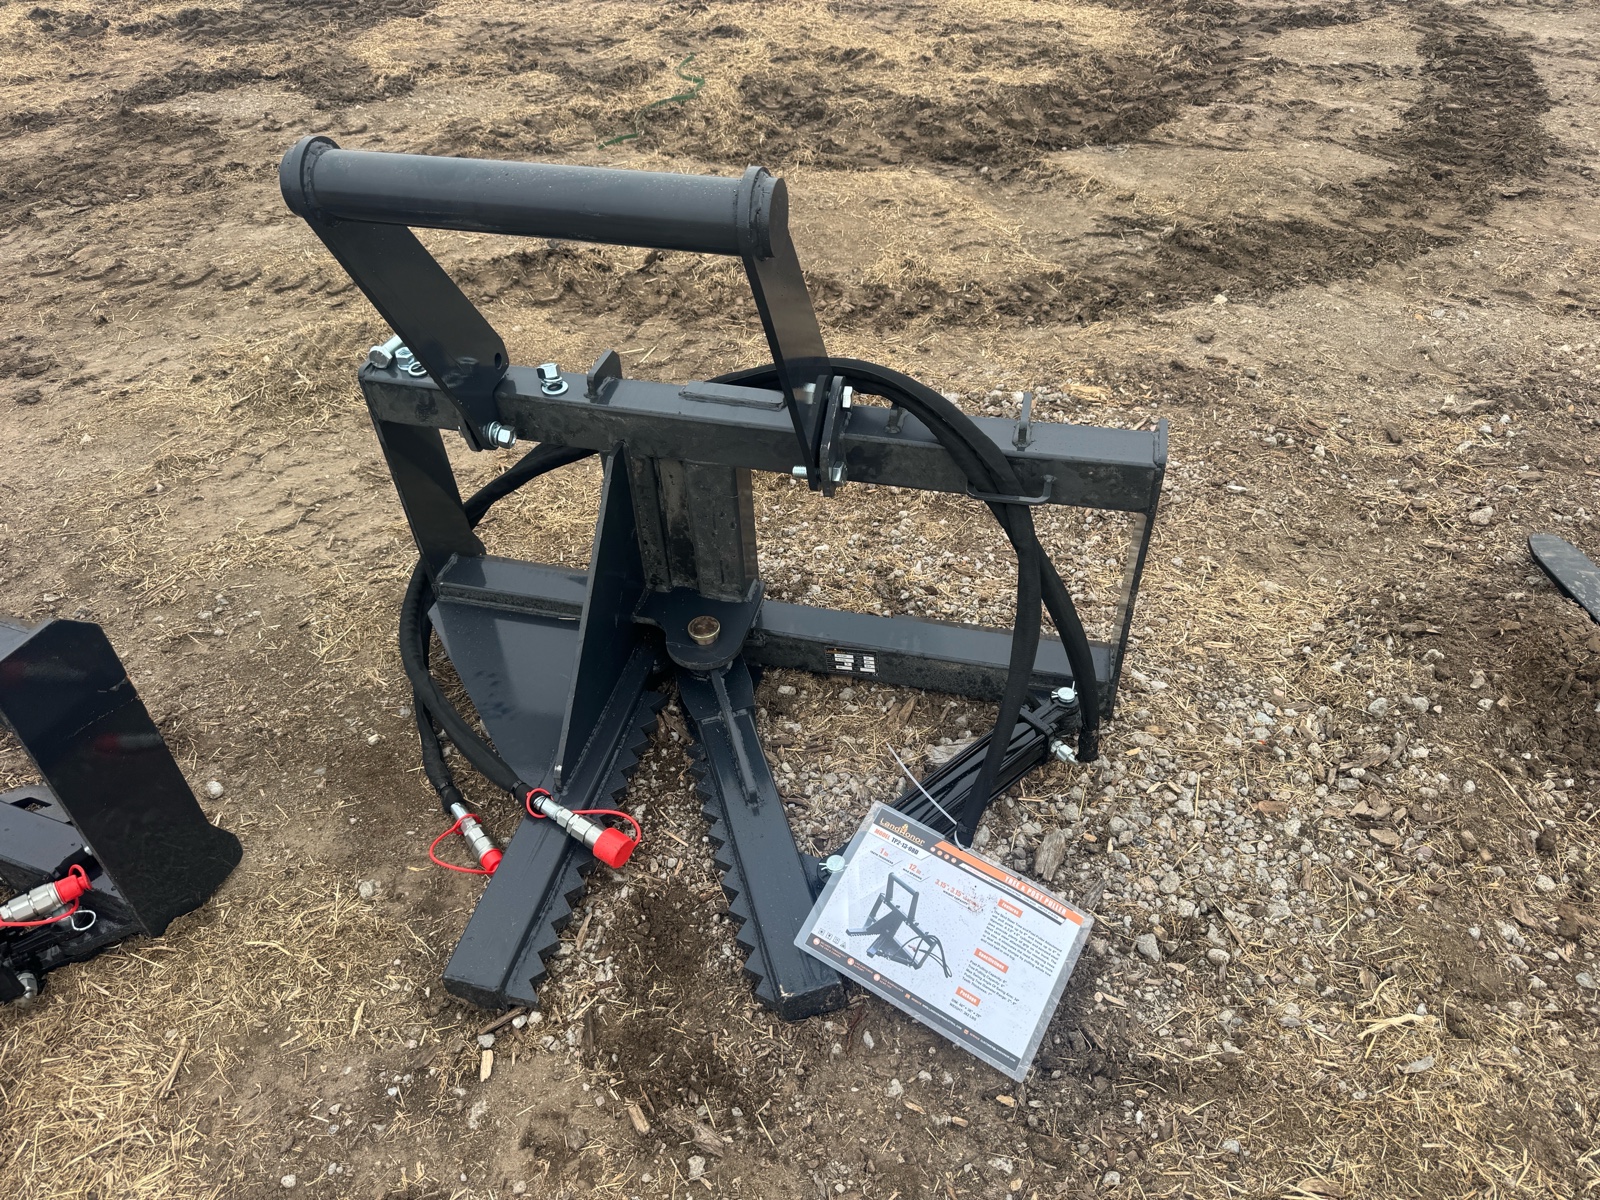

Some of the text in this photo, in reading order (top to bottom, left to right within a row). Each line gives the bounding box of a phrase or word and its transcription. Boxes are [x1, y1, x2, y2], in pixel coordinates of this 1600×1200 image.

[873, 827, 891, 840] MODEL
[879, 817, 926, 847] LandHonor
[908, 862, 917, 871] 12
[934, 878, 949, 890] 3.15"
[949, 886, 964, 898] 3.15"
[1004, 876, 1020, 889] TREE
[1026, 887, 1043, 901] POST
[1043, 897, 1067, 915] PULLER
[1001, 901, 1019, 915] Features
[974, 968, 986, 977] Pulling
[976, 964, 988, 973] Pulling
[963, 972, 975, 981] Pulling
[958, 989, 977, 1003] Package
